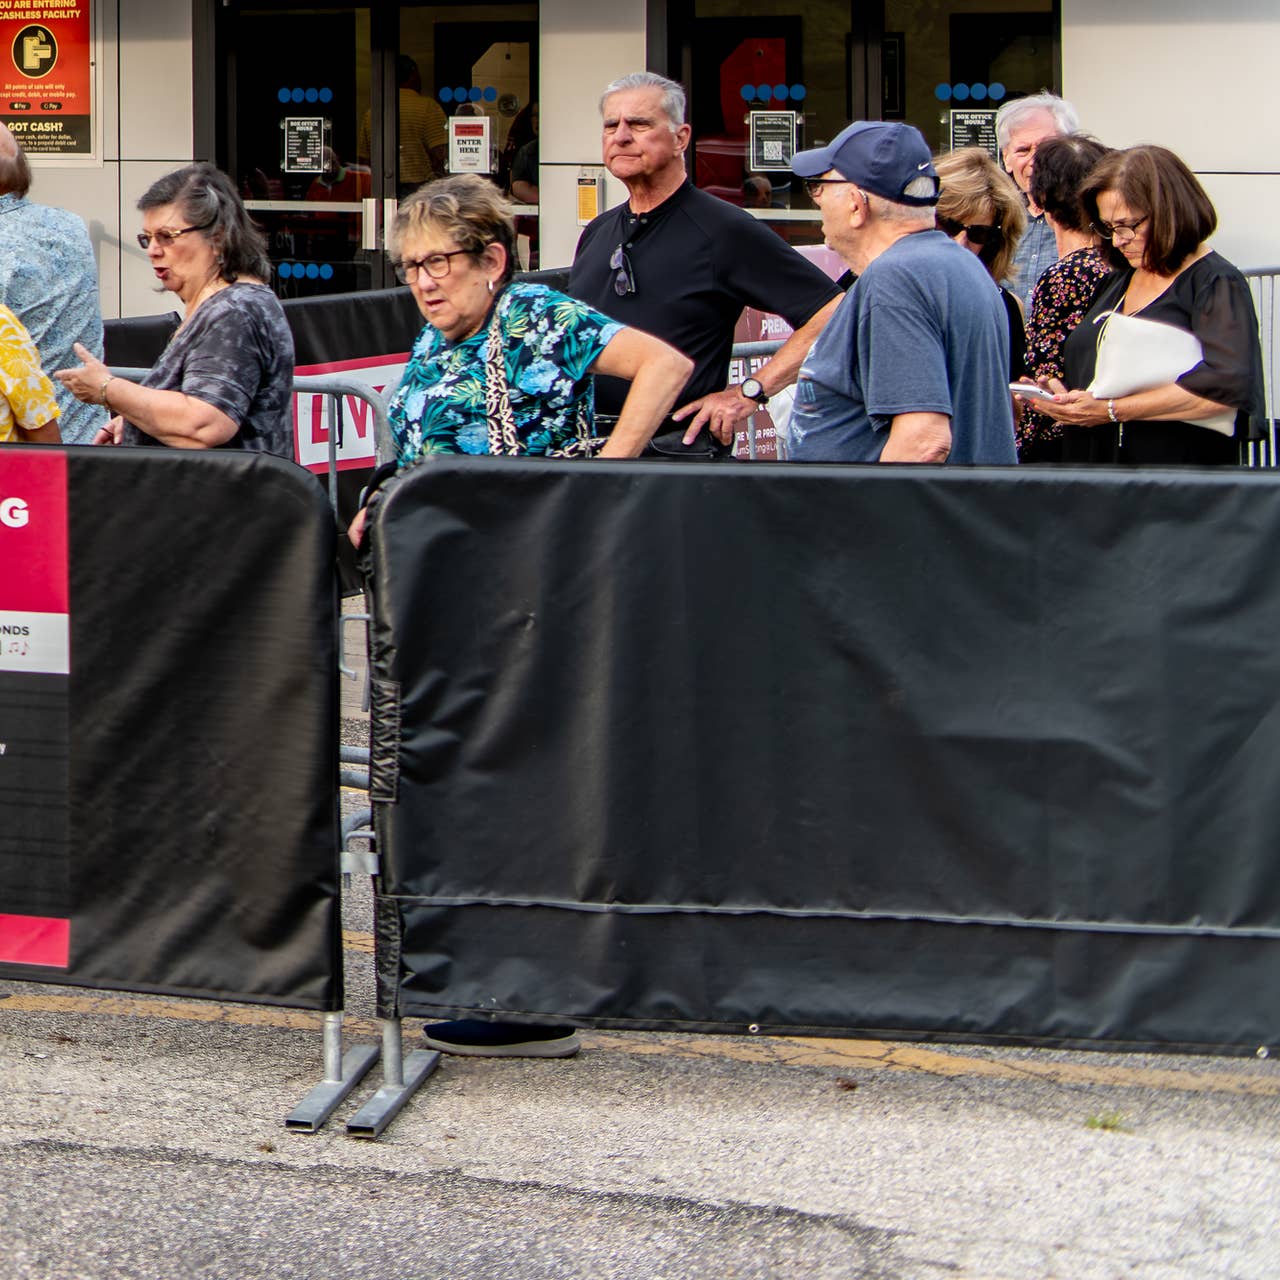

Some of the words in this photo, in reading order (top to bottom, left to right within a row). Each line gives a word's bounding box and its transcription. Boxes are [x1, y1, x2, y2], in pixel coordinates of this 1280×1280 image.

[14, 0, 31, 9] ARE
[32, 0, 77, 8] ENTERING
[43, 10, 81, 19] FACILITY
[8, 123, 28, 132] GOT
[30, 122, 63, 132] CASH?
